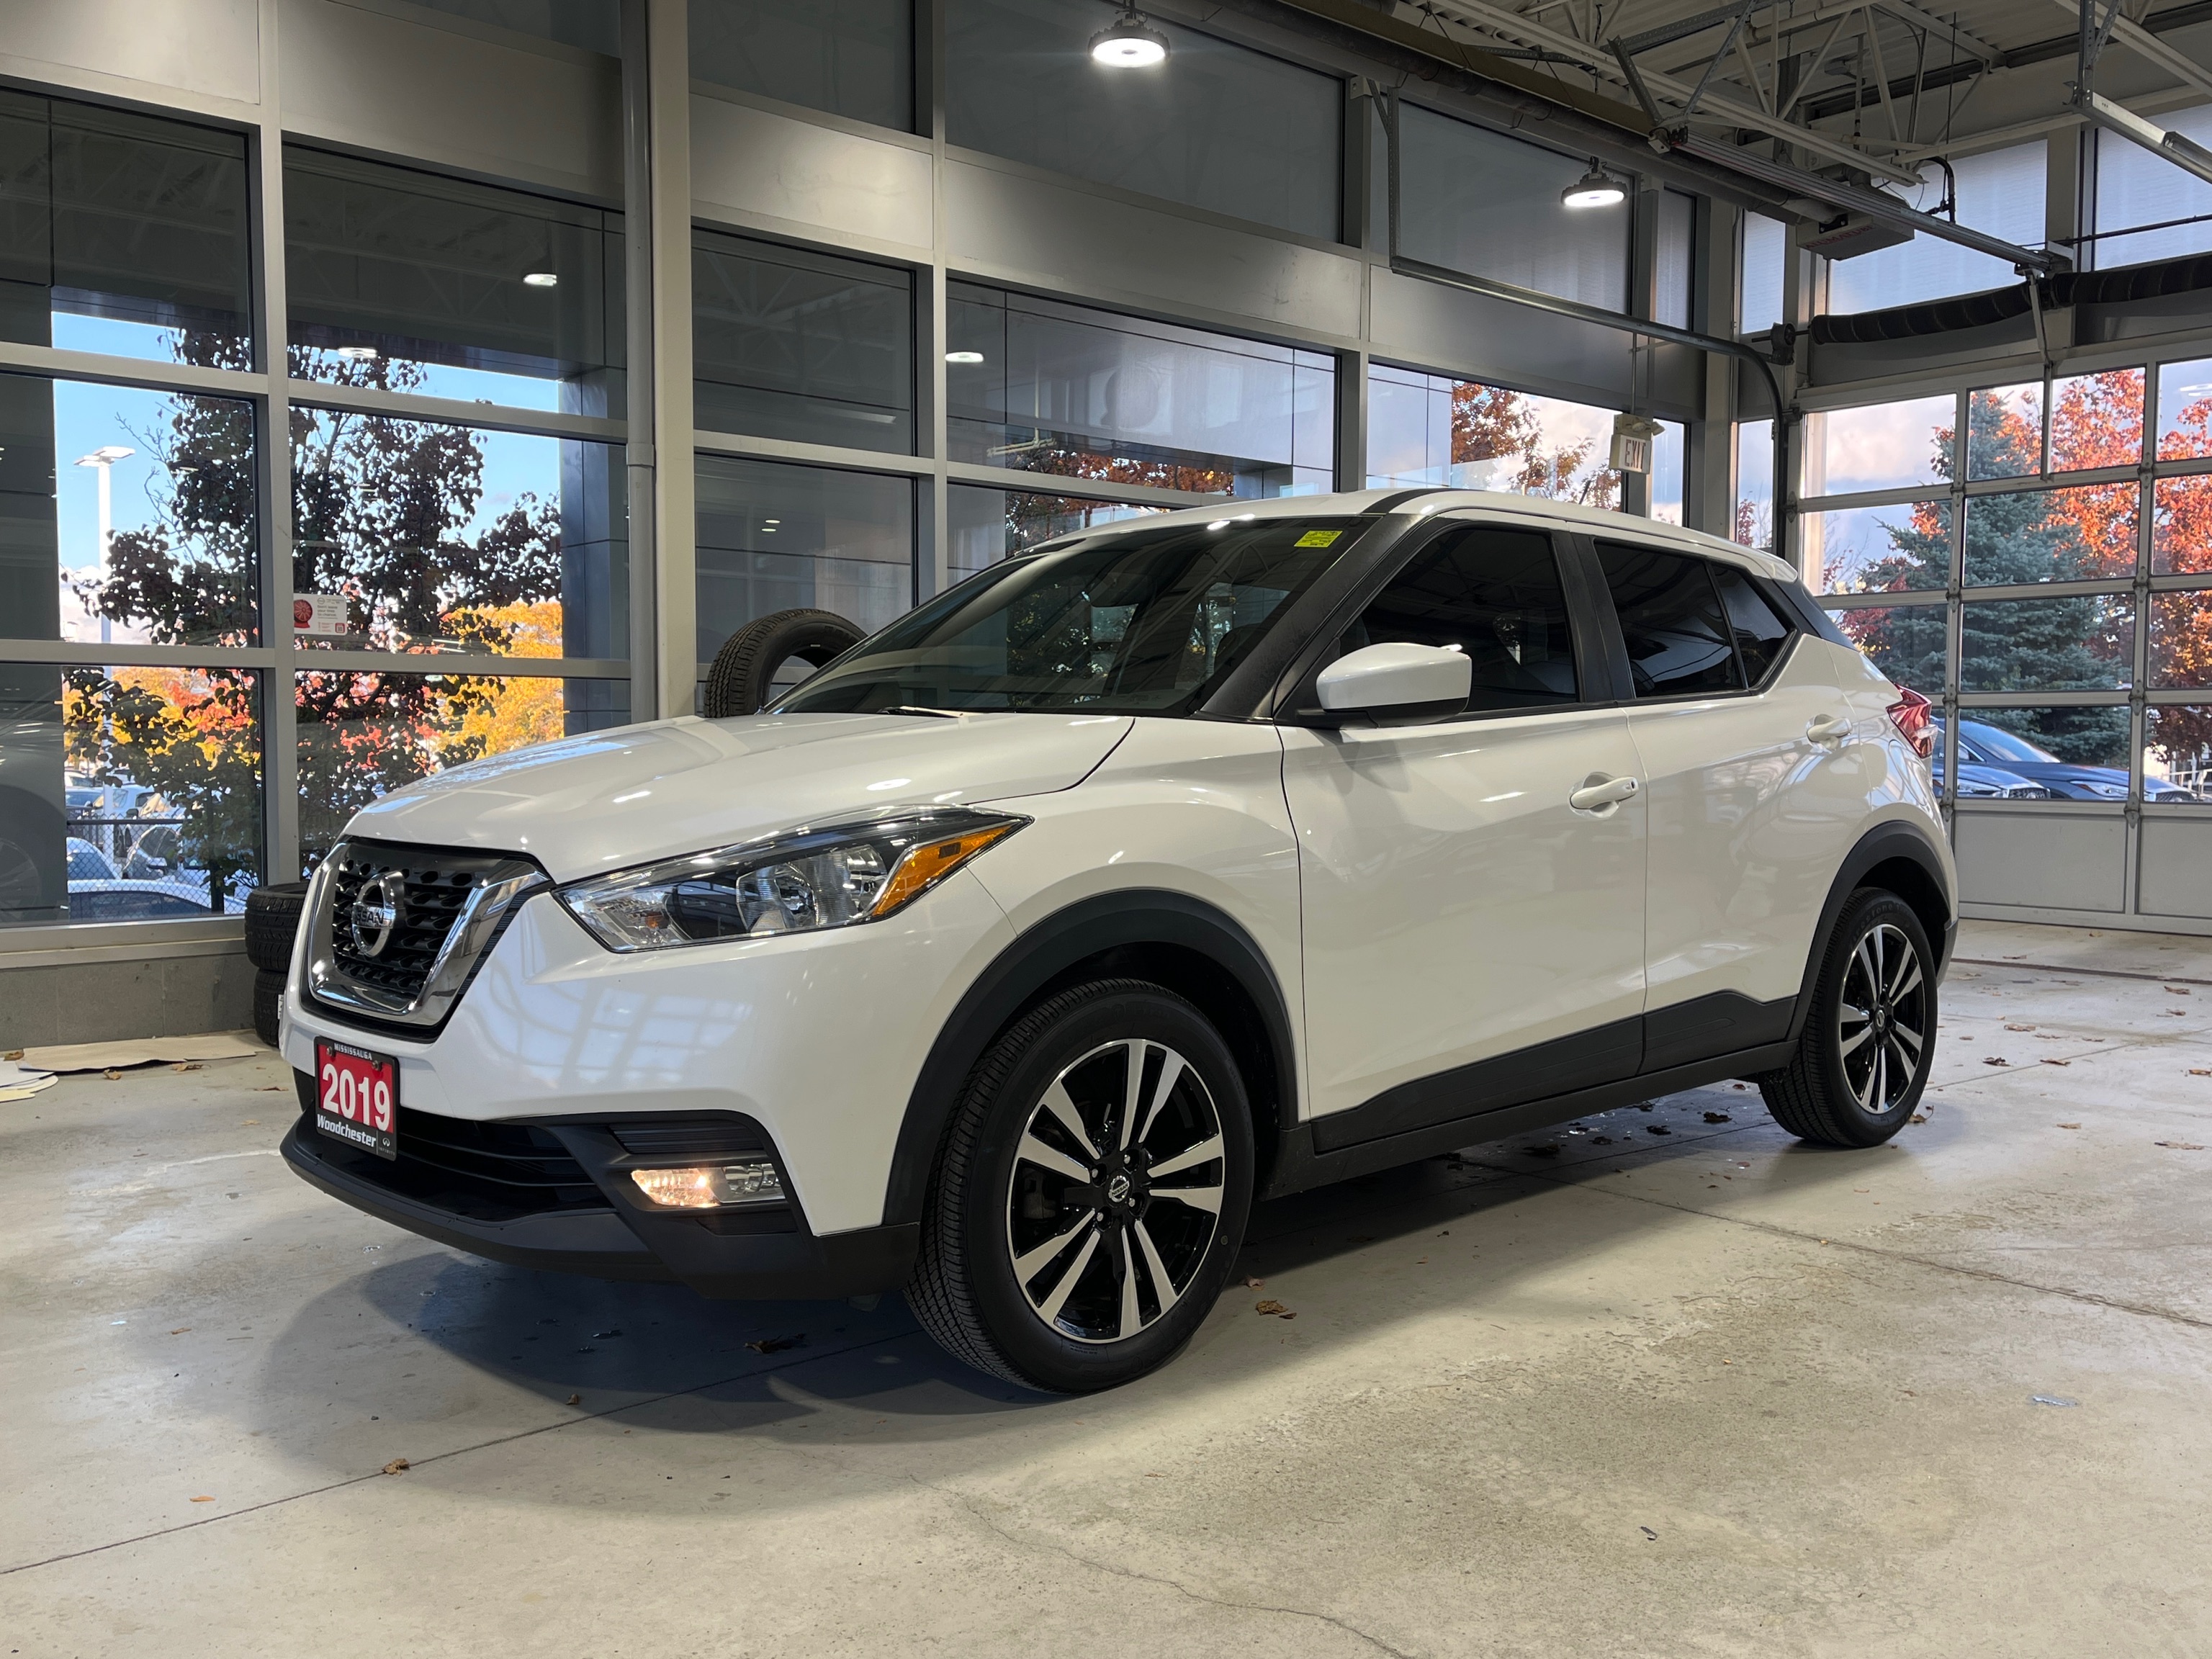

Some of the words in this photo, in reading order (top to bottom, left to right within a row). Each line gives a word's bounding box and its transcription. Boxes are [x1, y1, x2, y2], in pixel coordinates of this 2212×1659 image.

[1624, 439, 1646, 469] EXIT
[333, 1043, 372, 1061] MISSISSAUGA
[322, 1063, 390, 1131] 2019
[317, 1113, 377, 1148] Woodchester
